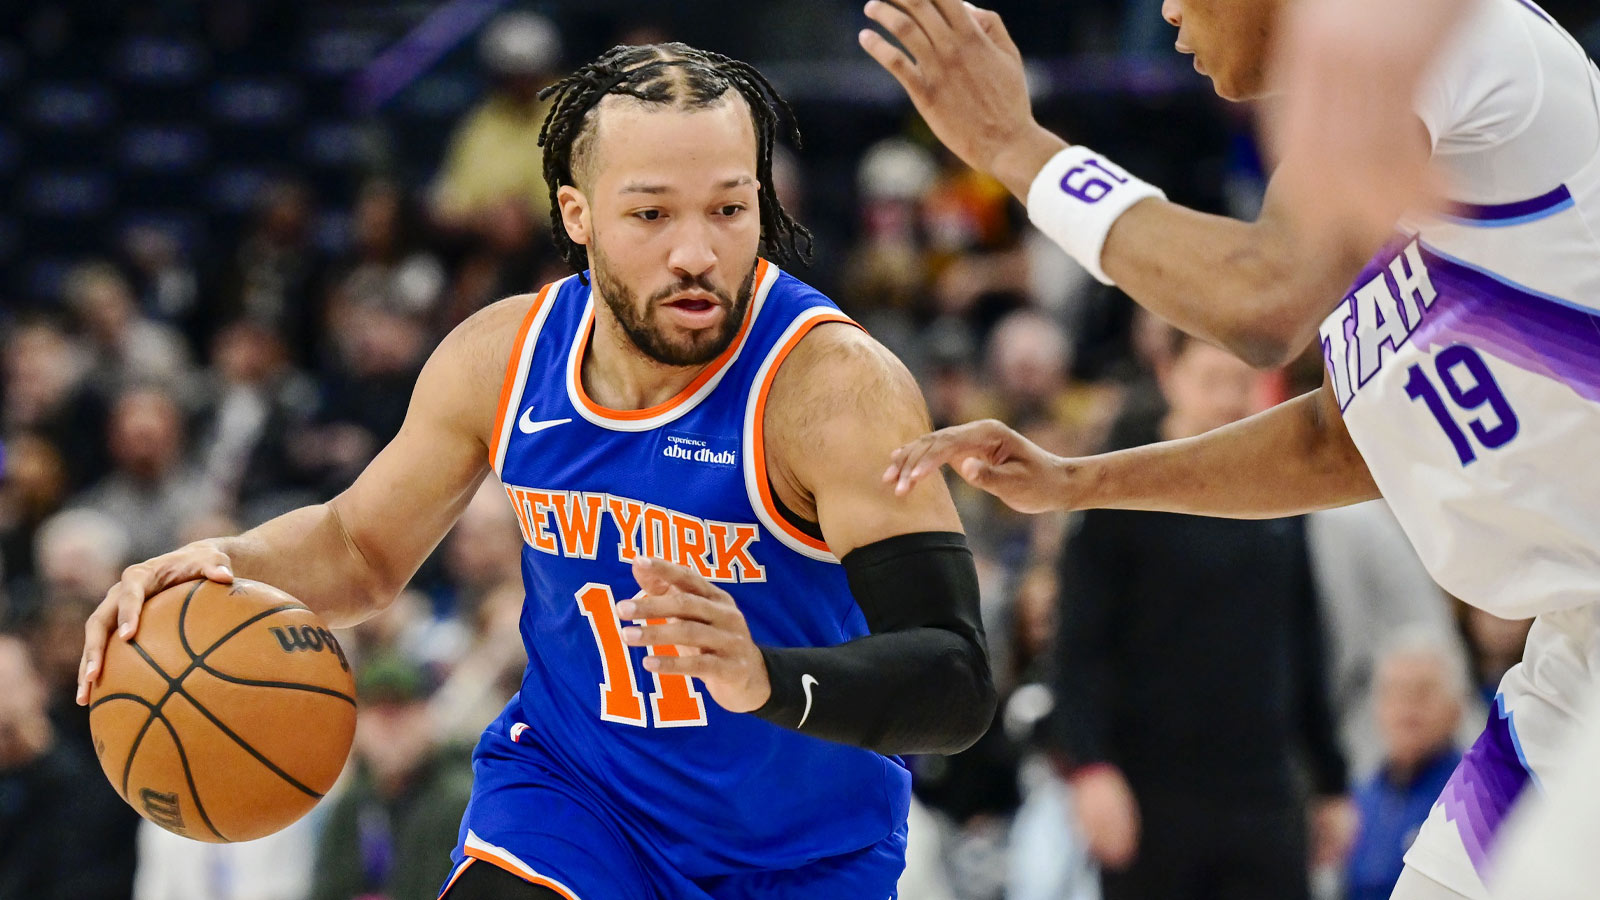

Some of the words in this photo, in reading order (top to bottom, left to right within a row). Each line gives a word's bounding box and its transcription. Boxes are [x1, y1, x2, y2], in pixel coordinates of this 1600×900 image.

[663, 444, 692, 460] abu
[693, 448, 736, 464] dhabi
[667, 435, 707, 447] experience
[1402, 344, 1520, 468] 19
[502, 482, 606, 560] NEW
[606, 491, 767, 583] YORK
[574, 582, 708, 728] 11
